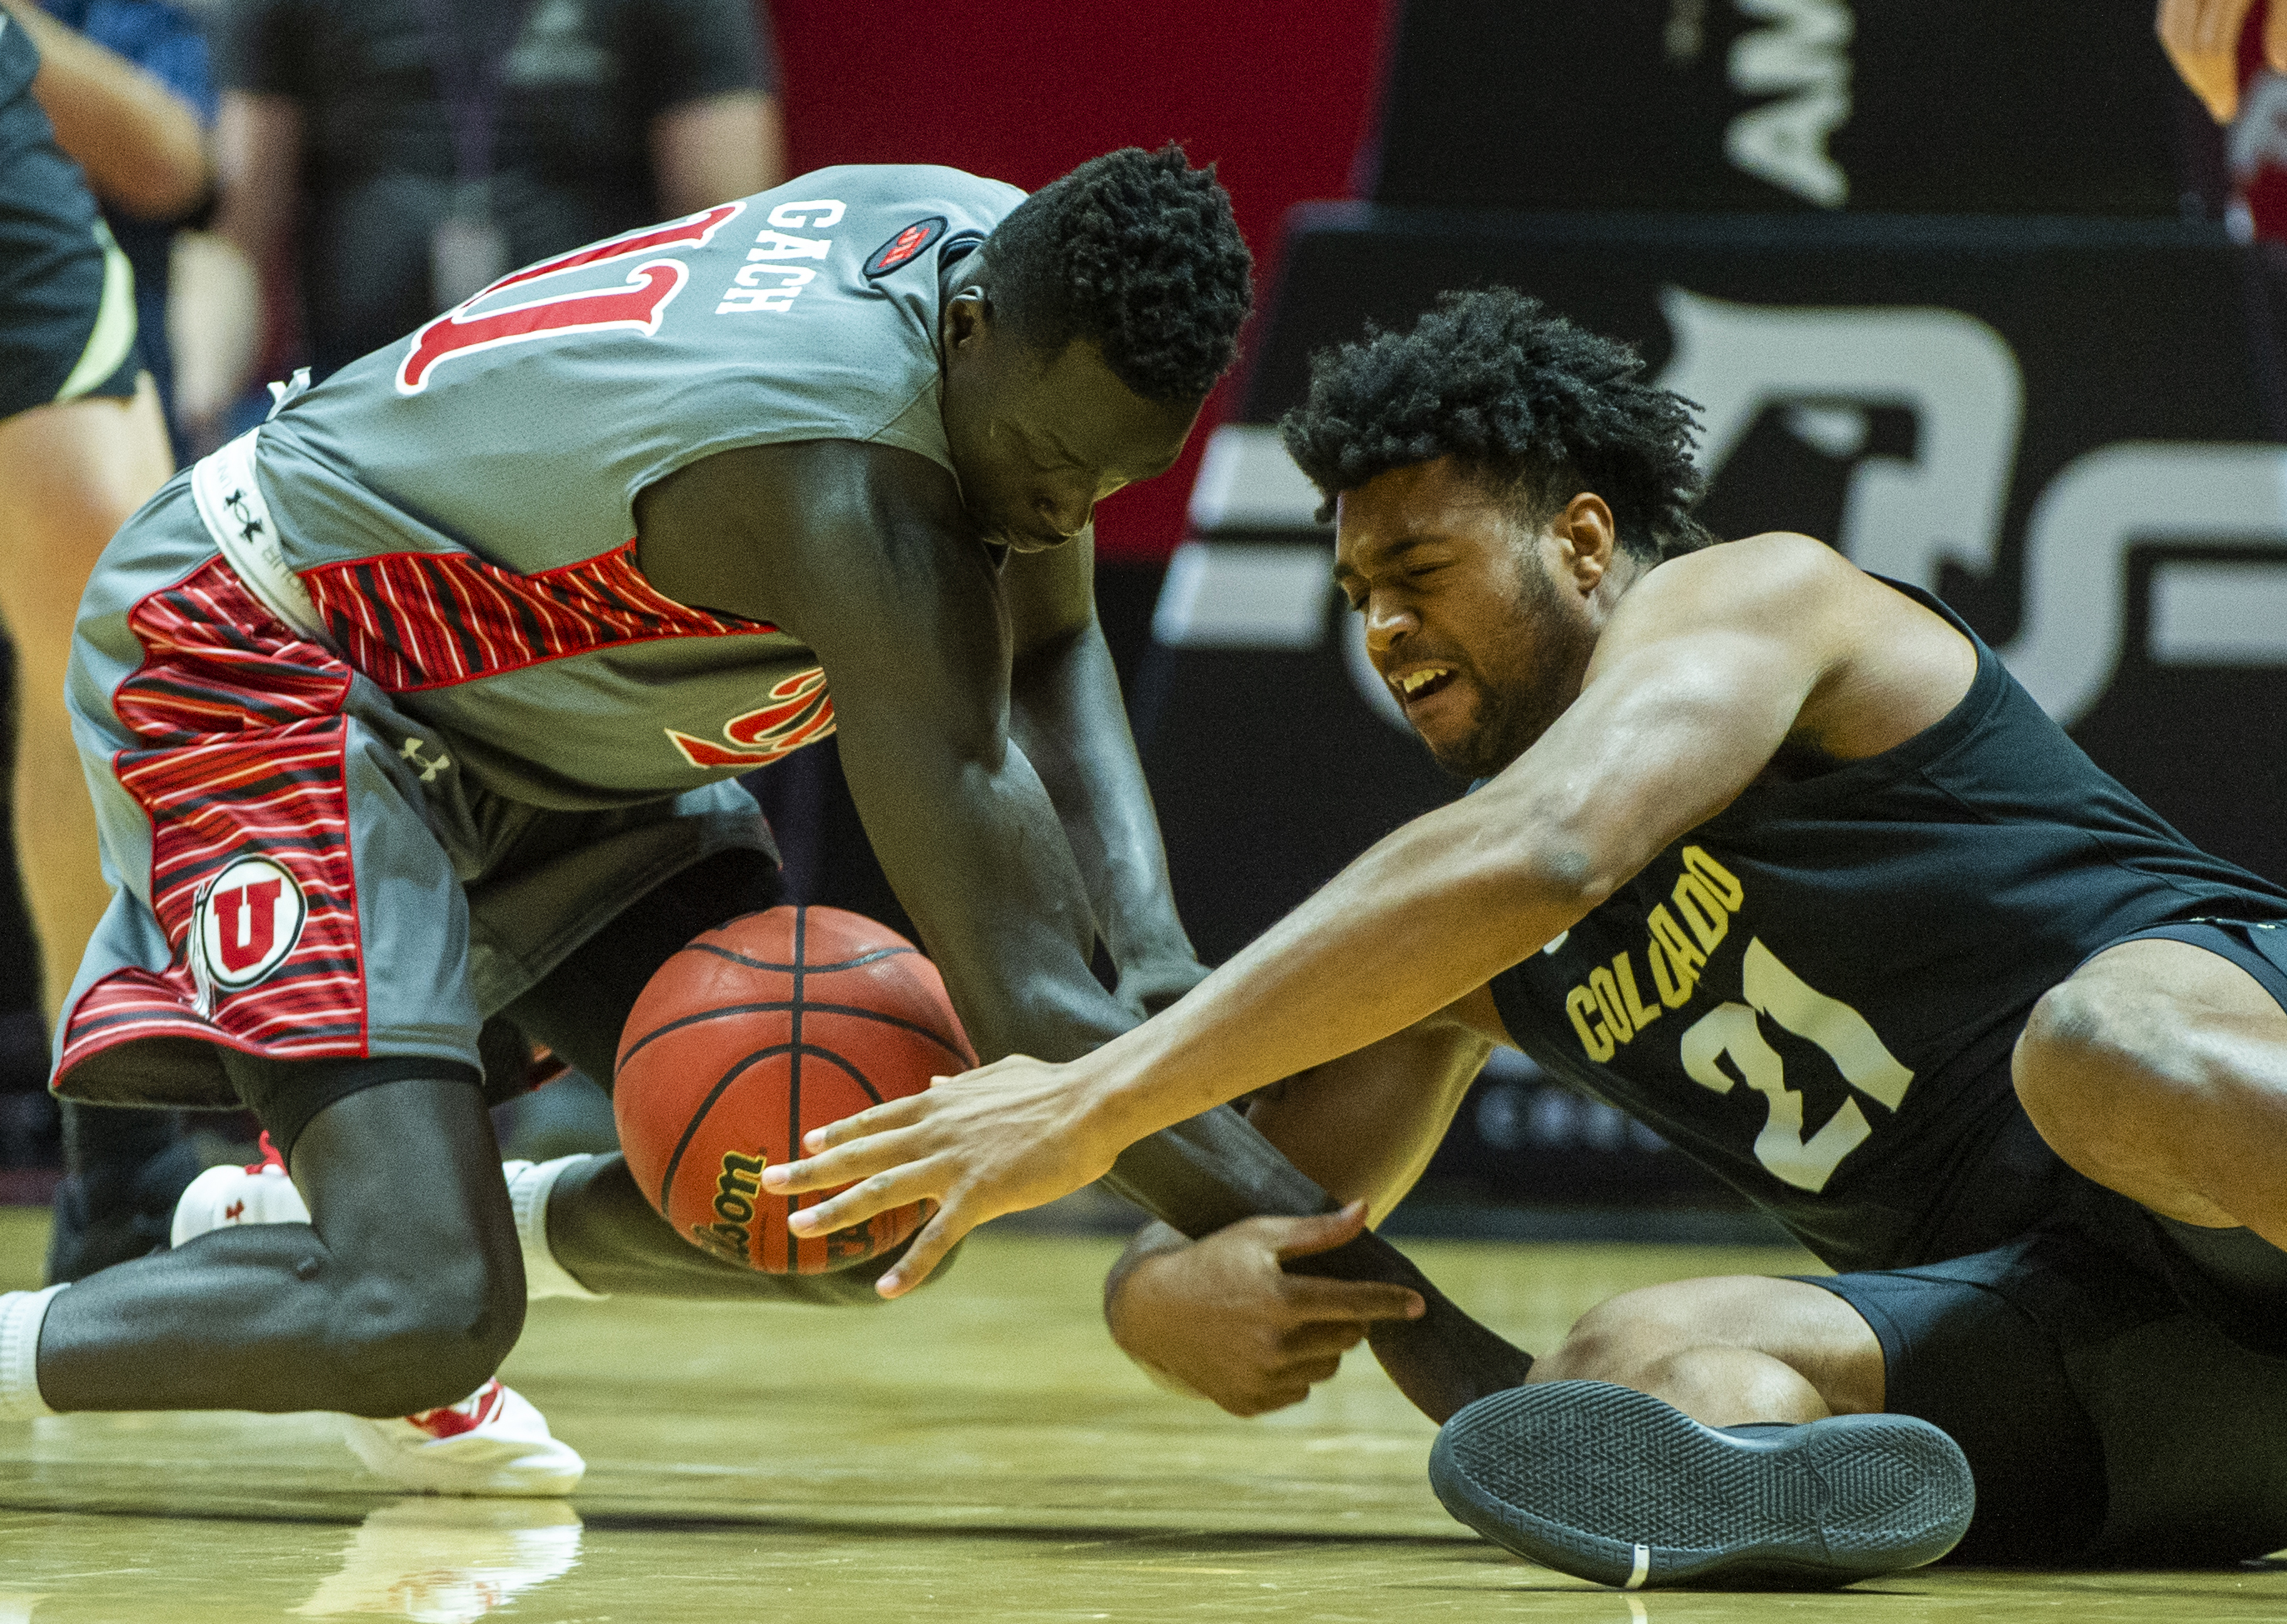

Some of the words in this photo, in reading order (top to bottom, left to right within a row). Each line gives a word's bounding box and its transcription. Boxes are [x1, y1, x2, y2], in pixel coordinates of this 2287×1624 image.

[715, 199, 847, 314] GACH
[213, 877, 282, 973] U
[1680, 935, 1915, 1193] 21
